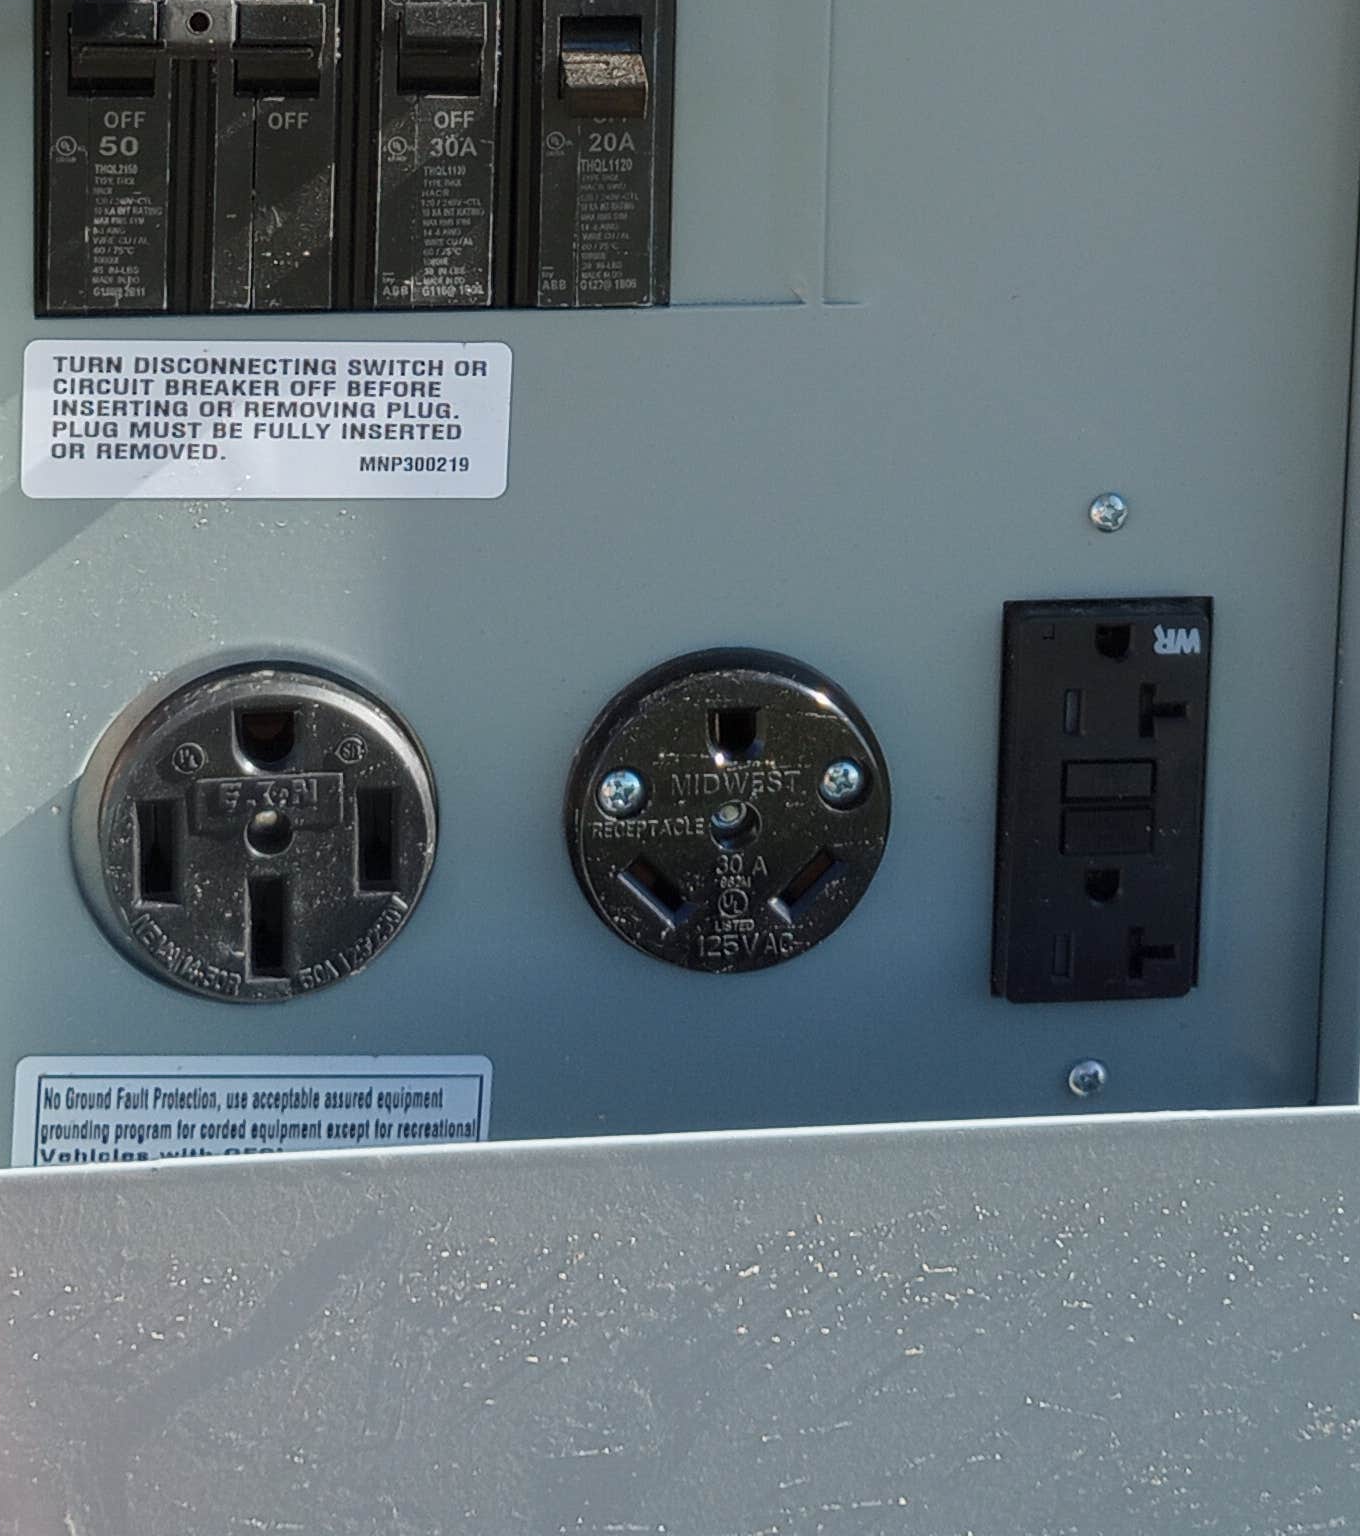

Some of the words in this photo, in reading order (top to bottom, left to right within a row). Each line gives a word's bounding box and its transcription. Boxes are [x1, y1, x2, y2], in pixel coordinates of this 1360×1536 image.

[104, 112, 146, 129] OFF
[268, 113, 309, 130] OFF
[434, 111, 475, 129] OFF
[99, 137, 139, 156] 50
[430, 137, 477, 157] 30A
[589, 132, 635, 152] 20A
[53, 356, 121, 372] TURN
[134, 357, 336, 375] DISCONNECTING
[347, 359, 442, 376] SWITCH
[454, 360, 486, 376] OR
[53, 378, 154, 395] CIRCUIT
[165, 379, 278, 395] BREAKER
[290, 380, 336, 396] OFF
[347, 380, 441, 397] BEFORE
[53, 400, 187, 416] INSERTING
[199, 401, 232, 417] OR
[244, 401, 374, 418] REMOVING
[387, 402, 458, 418] PLUG.
[52, 421, 117, 437] PLUG
[130, 421, 202, 438] MUST
[213, 422, 242, 438] BE
[254, 422, 330, 439] FULLY
[342, 423, 461, 439] INSERTED
[51, 443, 84, 458] OR
[96, 443, 225, 459] REMOVED.
[360, 456, 468, 471] MNP300219
[1153, 624, 1200, 654] WR
[671, 771, 801, 796] MIDWEST
[591, 816, 704, 839] RECEPTACLE
[716, 855, 742, 874] 30
[43, 1086, 61, 1110] No
[65, 1087, 111, 1110] Ground
[116, 1087, 148, 1109] Fault
[153, 1087, 220, 1111] Protection,
[226, 1092, 247, 1109] use
[252, 1087, 319, 1112] acceptable
[324, 1086, 372, 1109] assured
[377, 1087, 442, 1113] equipment
[40, 1119, 110, 1145] grounding
[114, 1123, 171, 1144] program
[177, 1119, 195, 1139] for
[200, 1119, 246, 1139] corded
[251, 1119, 321, 1143] equipment
[326, 1119, 369, 1142] except
[374, 1118, 393, 1138] for
[397, 1119, 476, 1139] recreational
